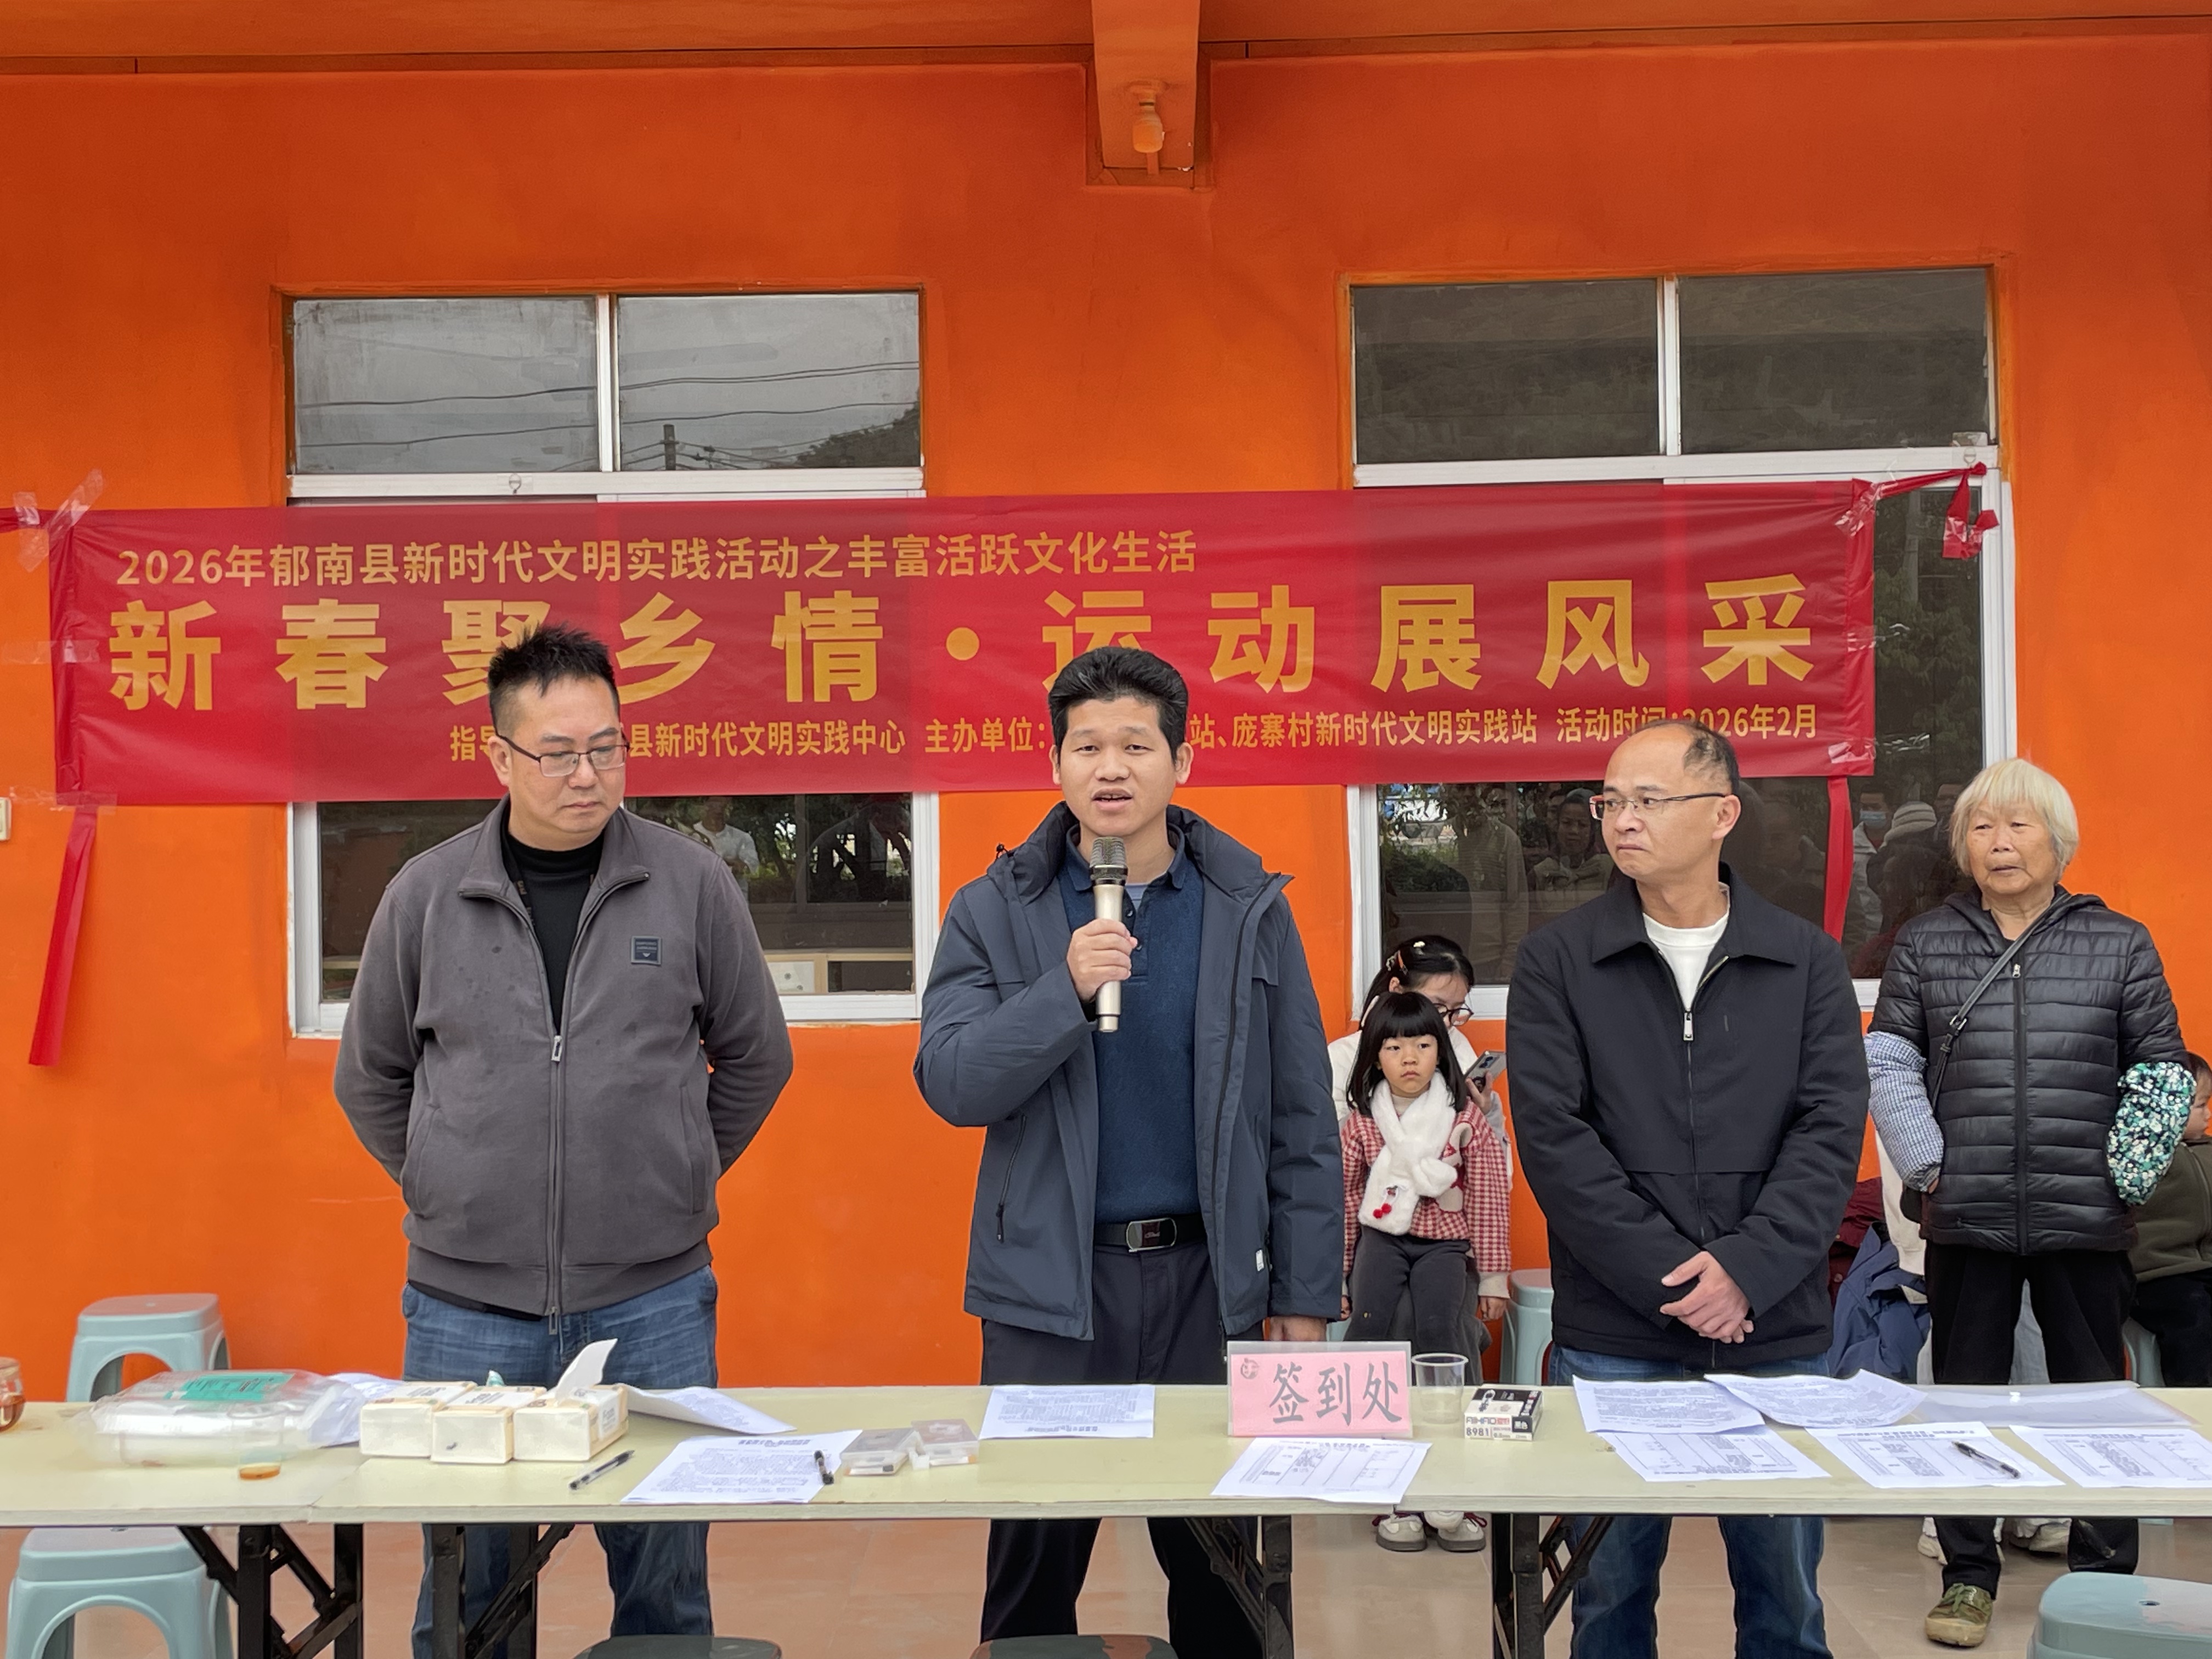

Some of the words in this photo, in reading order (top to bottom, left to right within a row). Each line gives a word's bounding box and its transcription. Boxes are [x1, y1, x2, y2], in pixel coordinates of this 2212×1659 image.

[117, 530, 1197, 587] 2026年郁南县新时代文明实践活动之丰富活跃文化生活
[1269, 1361, 1403, 1426] 签到处
[1466, 1427, 1489, 1436] 8981
